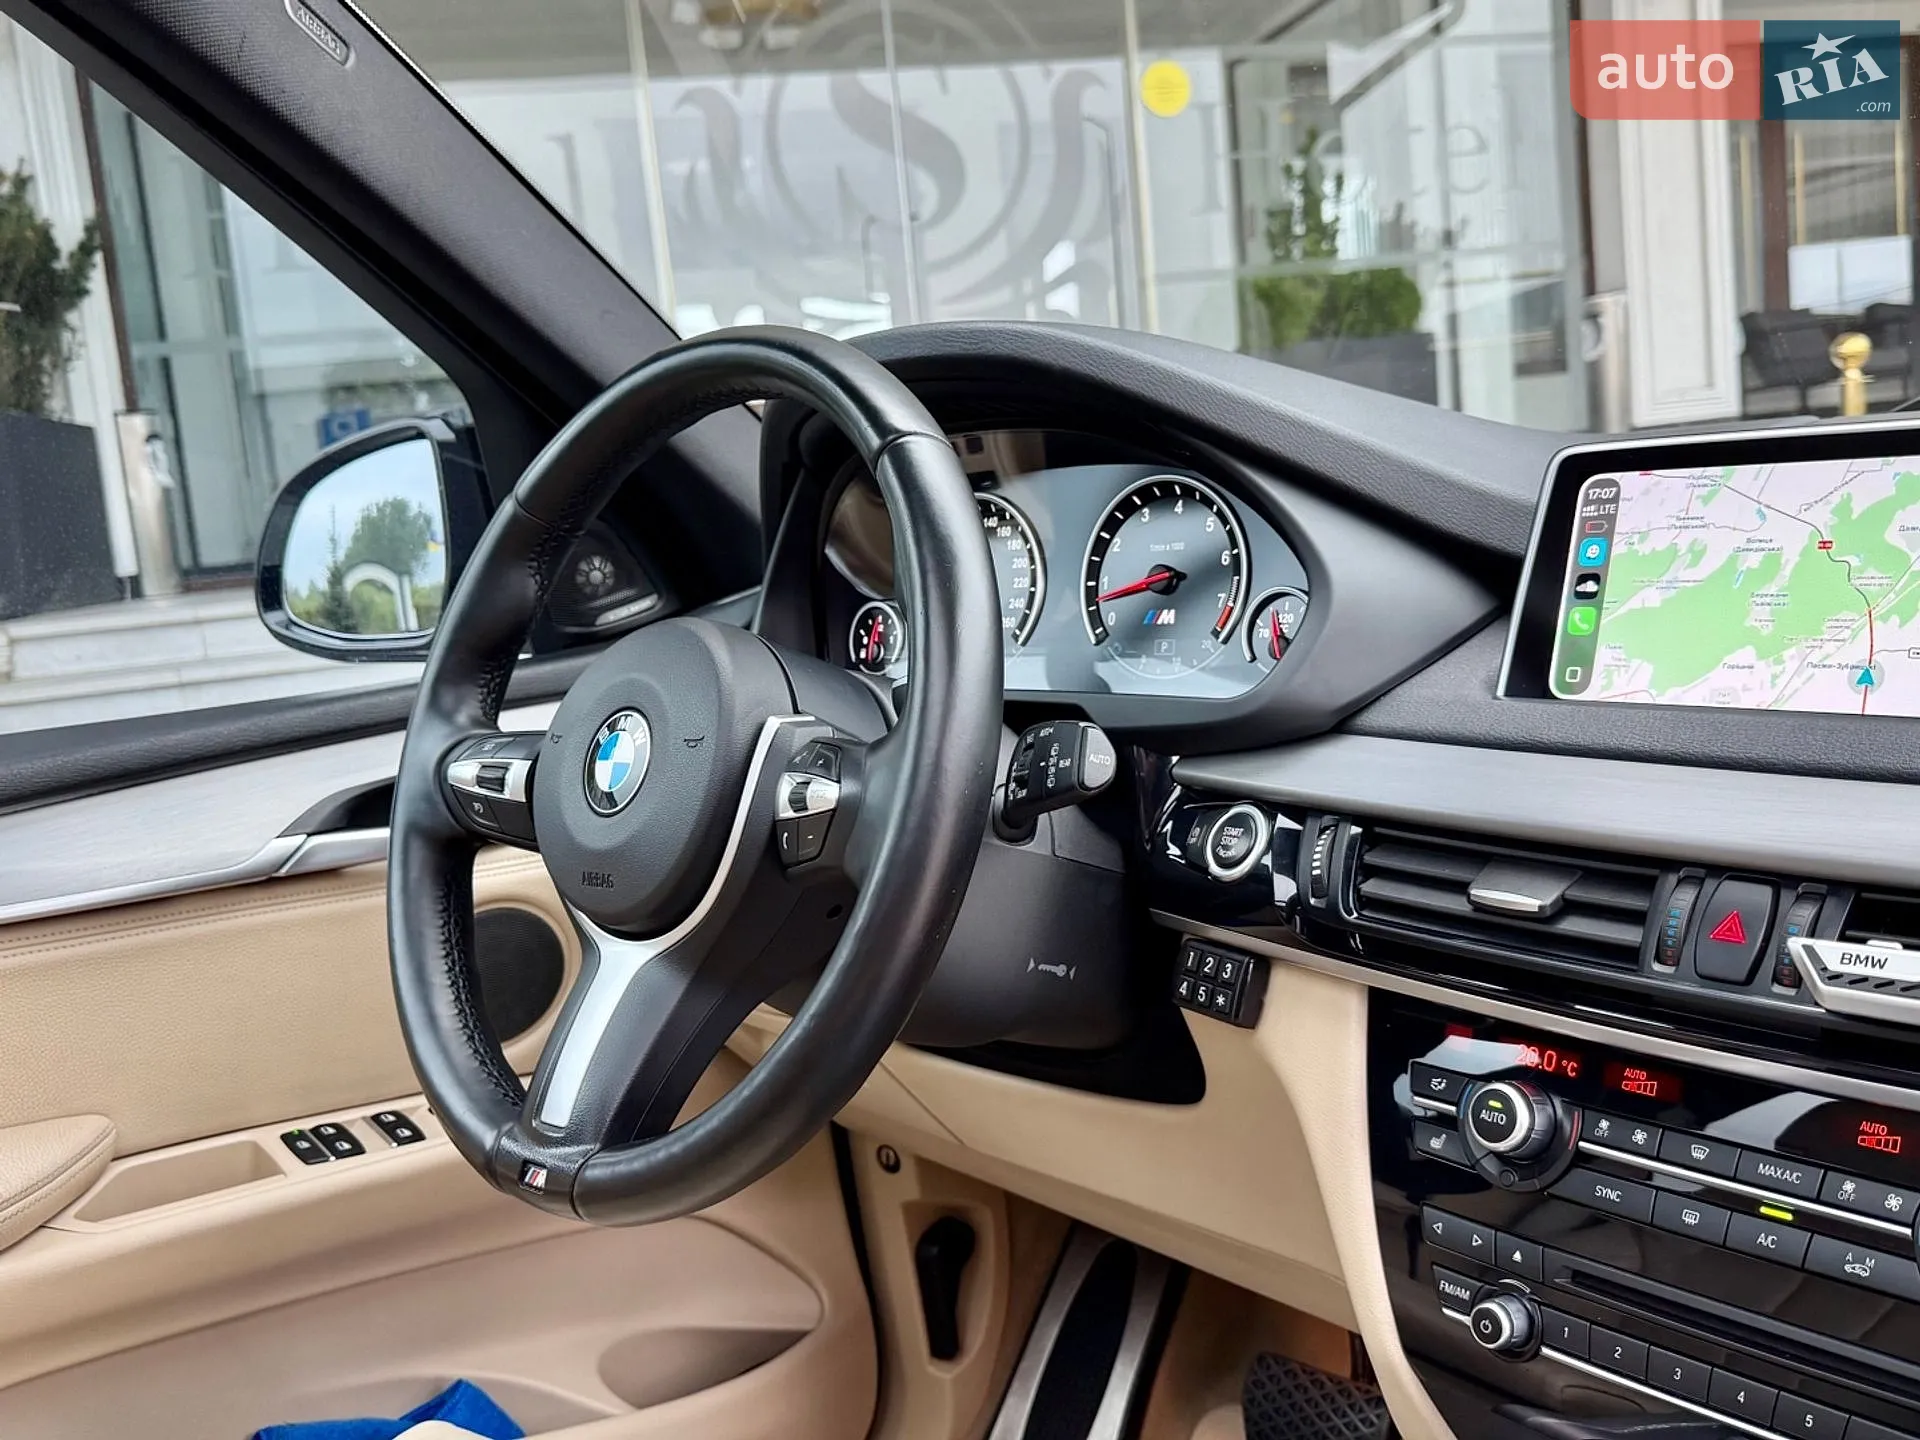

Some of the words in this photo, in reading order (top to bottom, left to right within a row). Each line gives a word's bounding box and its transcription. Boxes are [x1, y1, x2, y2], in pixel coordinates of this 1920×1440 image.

[1589, 487, 1616, 500] 17:07
[1173, 500, 1183, 514] 4
[1600, 504, 1617, 515] LTE
[1141, 508, 1150, 522] 3
[983, 517, 998, 528] 140
[1205, 518, 1214, 532] 5
[1112, 538, 1121, 552] 2
[1012, 558, 1027, 569] 200
[1221, 551, 1230, 565] 6
[1013, 578, 1028, 588] 220
[1102, 580, 1109, 591] 1
[1009, 599, 1024, 609] 240
[1217, 593, 1227, 608] 7
[1107, 612, 1116, 625] 0
[1156, 609, 1176, 625] M
[1279, 613, 1294, 624] 120
[1259, 629, 1270, 638] 70
[1161, 642, 1168, 653] P
[1089, 754, 1112, 766] AUTO
[1223, 826, 1244, 837] START
[1187, 951, 1195, 967] 1
[1203, 957, 1214, 973] 2
[1222, 963, 1232, 979] 3
[1840, 952, 1889, 970] BMW
[1179, 981, 1188, 996] 4
[1198, 986, 1207, 1002] 5
[1624, 1068, 1647, 1080] AUTO
[1480, 1109, 1507, 1126] AUTO
[1594, 1127, 1609, 1139] OFF
[1859, 1121, 1888, 1136] AUTO
[1757, 1163, 1783, 1180] MAX
[1783, 1171, 1802, 1184] A/C
[1595, 1185, 1622, 1202] SYNC
[1837, 1190, 1857, 1202] OFF
[1756, 1232, 1778, 1249] A/C
[1846, 1252, 1853, 1263] A
[1865, 1257, 1876, 1269] M
[1438, 1279, 1471, 1301] FM/AM
[1563, 1326, 1569, 1339] 1
[1613, 1346, 1622, 1359] 2
[1673, 1367, 1682, 1381] 3
[1737, 1390, 1746, 1404] 4
[1804, 1414, 1814, 1428] 5
